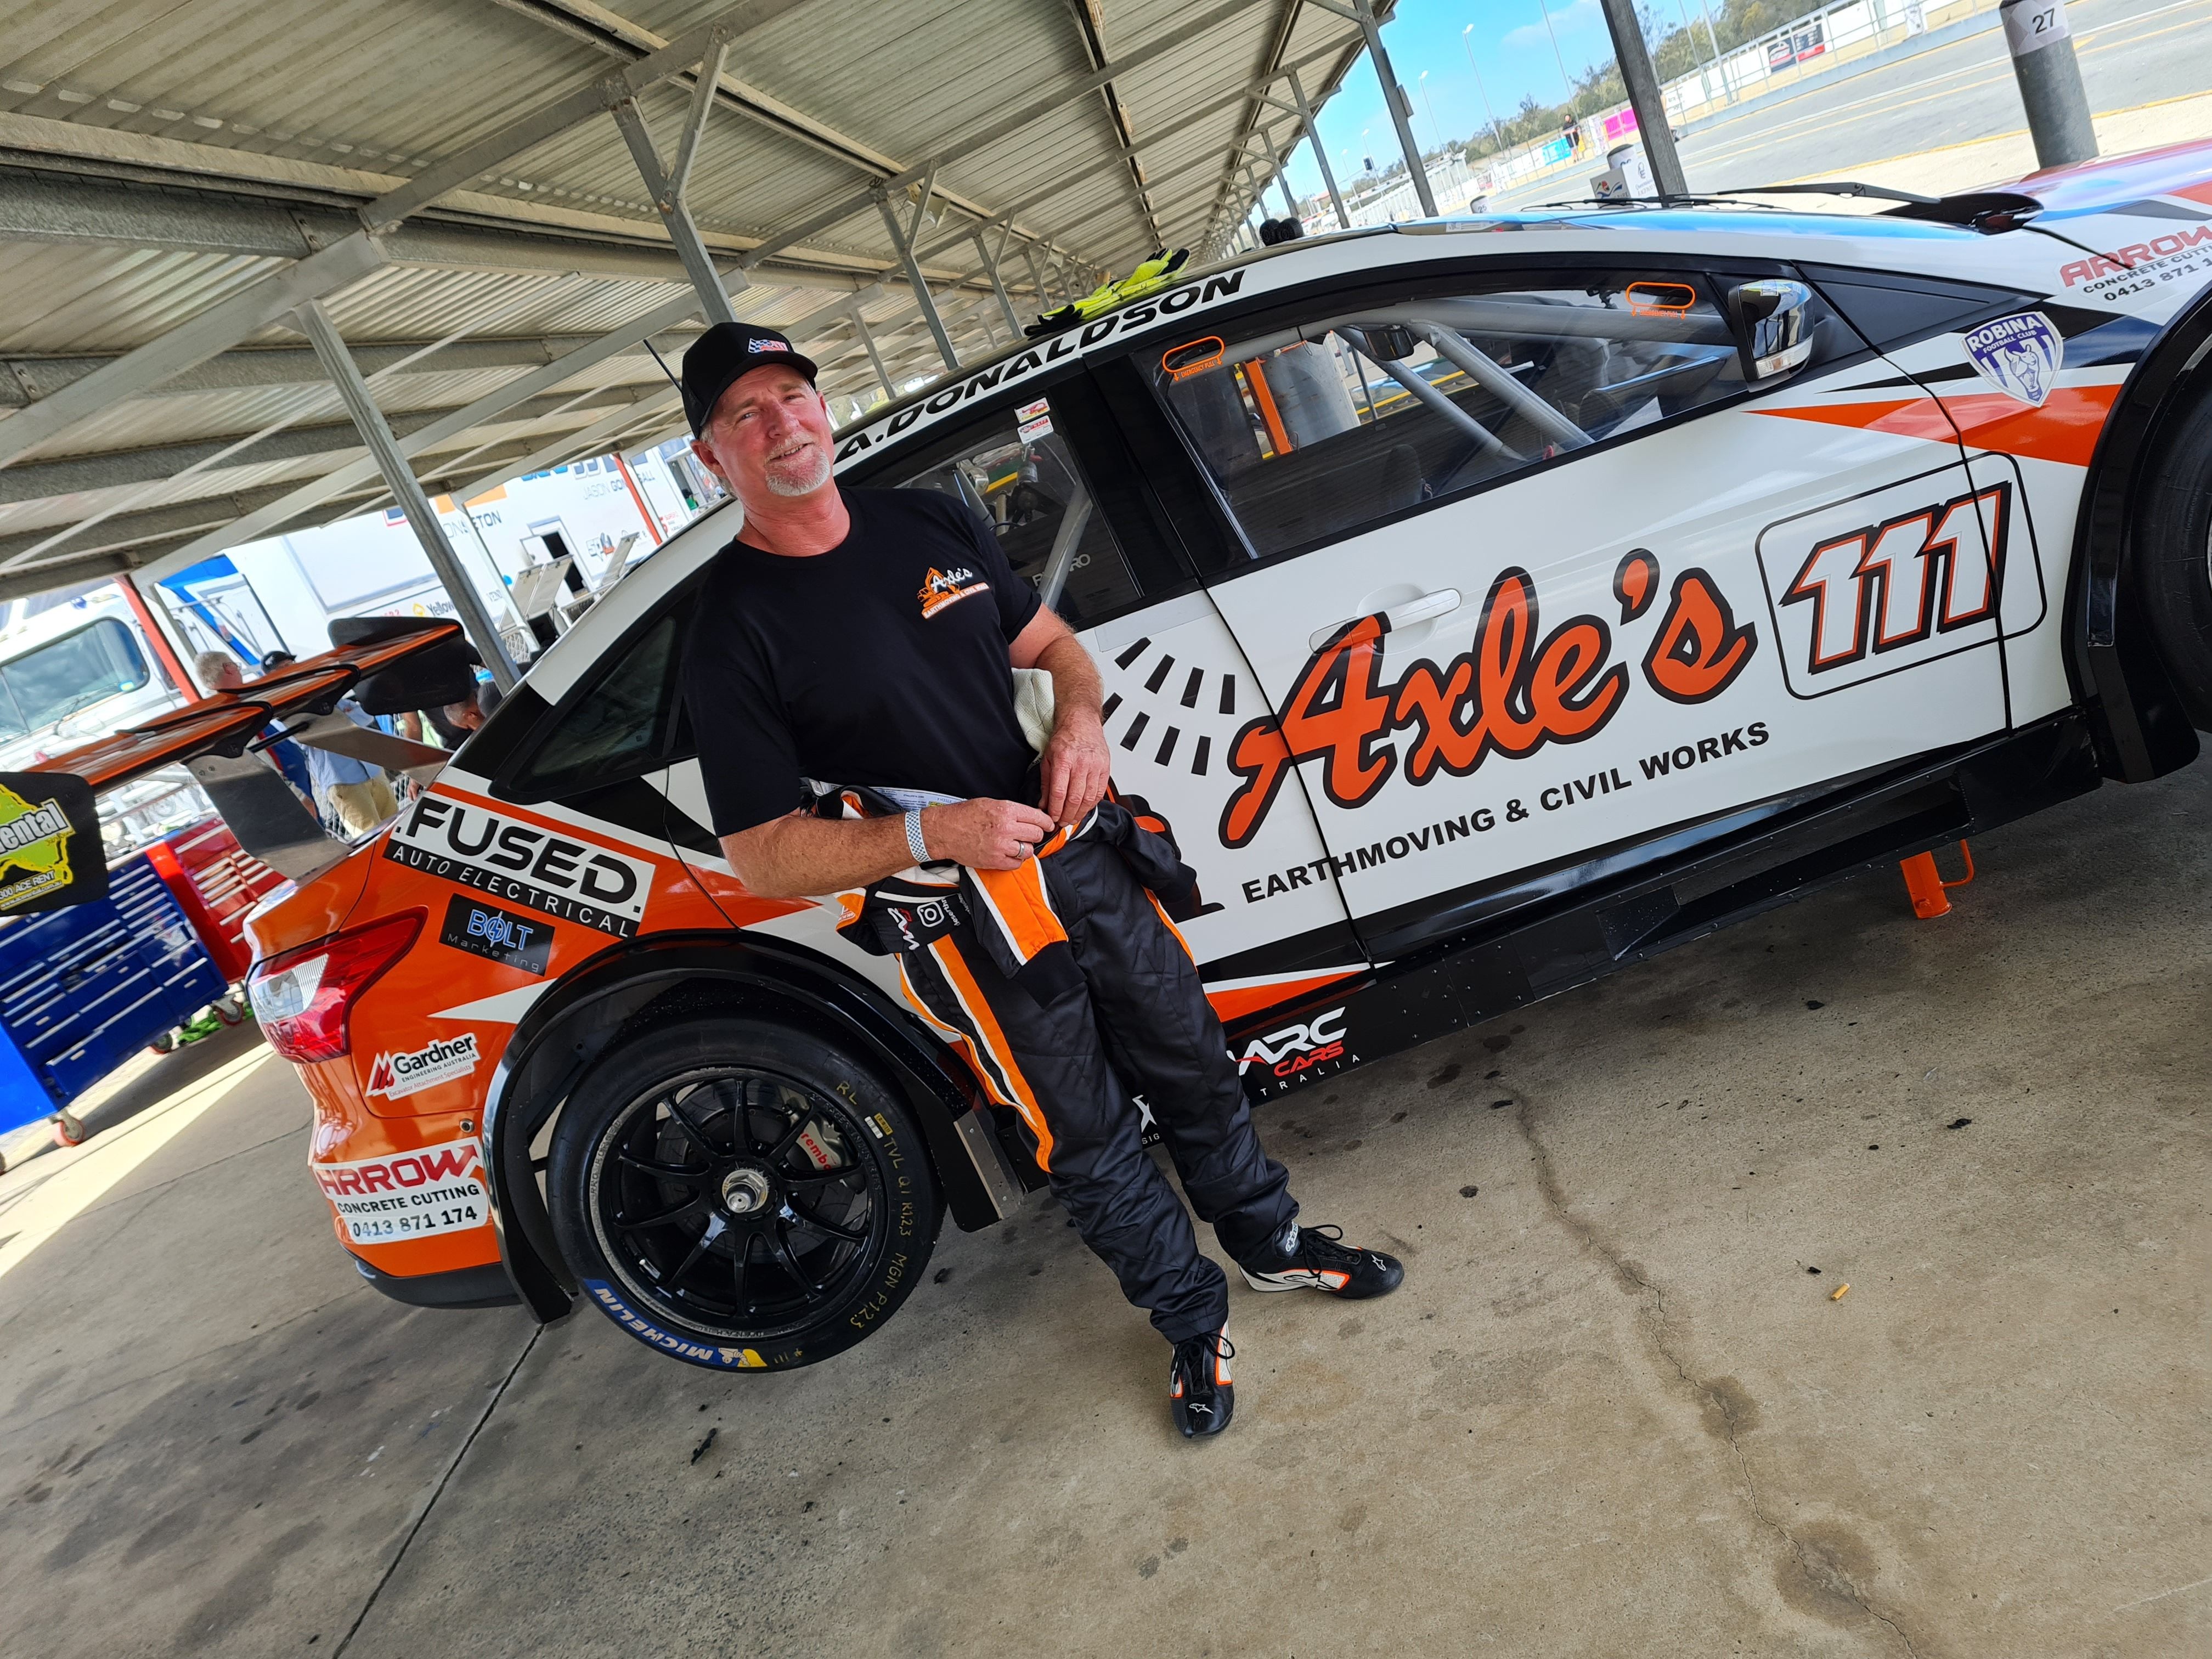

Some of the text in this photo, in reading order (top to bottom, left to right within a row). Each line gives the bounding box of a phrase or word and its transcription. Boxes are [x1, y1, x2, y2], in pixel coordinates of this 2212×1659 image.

[2032, 7, 2055, 35] 27
[2060, 225, 2212, 287] ARROW
[2083, 261, 2169, 293] CONCRETE
[2104, 279, 2156, 301] 0413
[2159, 264, 2200, 281] 871
[1968, 315, 2044, 353] ROBINA
[1983, 330, 2038, 354] FOOTBALL CLUB
[833, 270, 1245, 465] A.DONALDSON
[930, 567, 973, 593] Axle's
[1031, 554, 1091, 587] RRO
[1779, 481, 2012, 675] 111
[1219, 548, 1758, 849] Axle's
[0, 802, 68, 853] ental
[1241, 721, 1770, 904] EARTHMOVING & CIVIL WORKS
[15, 880, 33, 894] ACE
[33, 871, 55, 887] RENT
[393, 844, 629, 939] AUTO ELECTRICAL
[467, 909, 534, 951] BOLT
[447, 933, 540, 973] Marketing
[393, 1036, 473, 1074] Gardner
[401, 1052, 477, 1083] ENGINEERING AUSTRALIA
[1273, 1039, 1345, 1077] CARS
[388, 1064, 472, 1097] Excavator Attachment Specialists
[836, 1080, 858, 1105] RL
[1260, 1054, 1361, 1097] TRALIA
[316, 1144, 478, 1195] ARROW
[800, 1132, 832, 1170] rembo
[883, 1137, 905, 1169] TVL
[338, 1184, 480, 1215] CONCRETE CUTTING
[352, 1206, 477, 1238] 0413 871 174
[884, 1252, 907, 1288] MGN
[594, 1289, 714, 1361] MICHELIN
